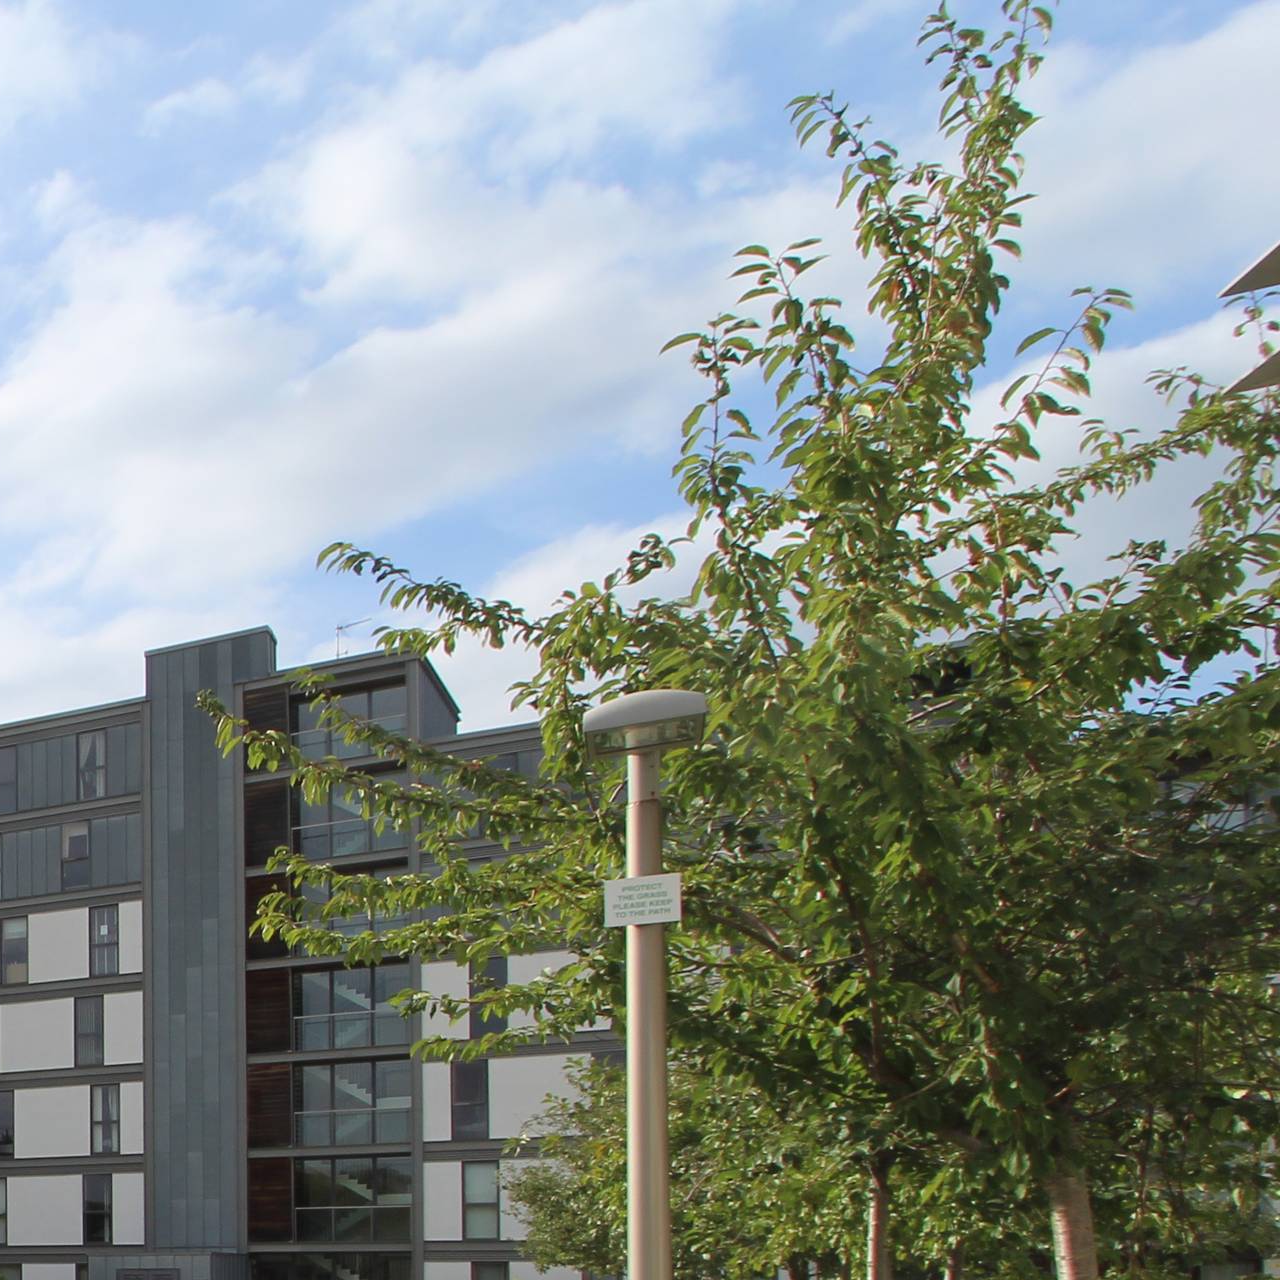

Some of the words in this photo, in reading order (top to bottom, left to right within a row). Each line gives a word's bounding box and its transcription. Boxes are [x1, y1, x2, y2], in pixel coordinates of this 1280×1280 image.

[622, 883, 663, 892] PROTECT
[637, 891, 667, 899] GRASS
[613, 901, 647, 910] PLEASE
[649, 899, 672, 907] KEEP
